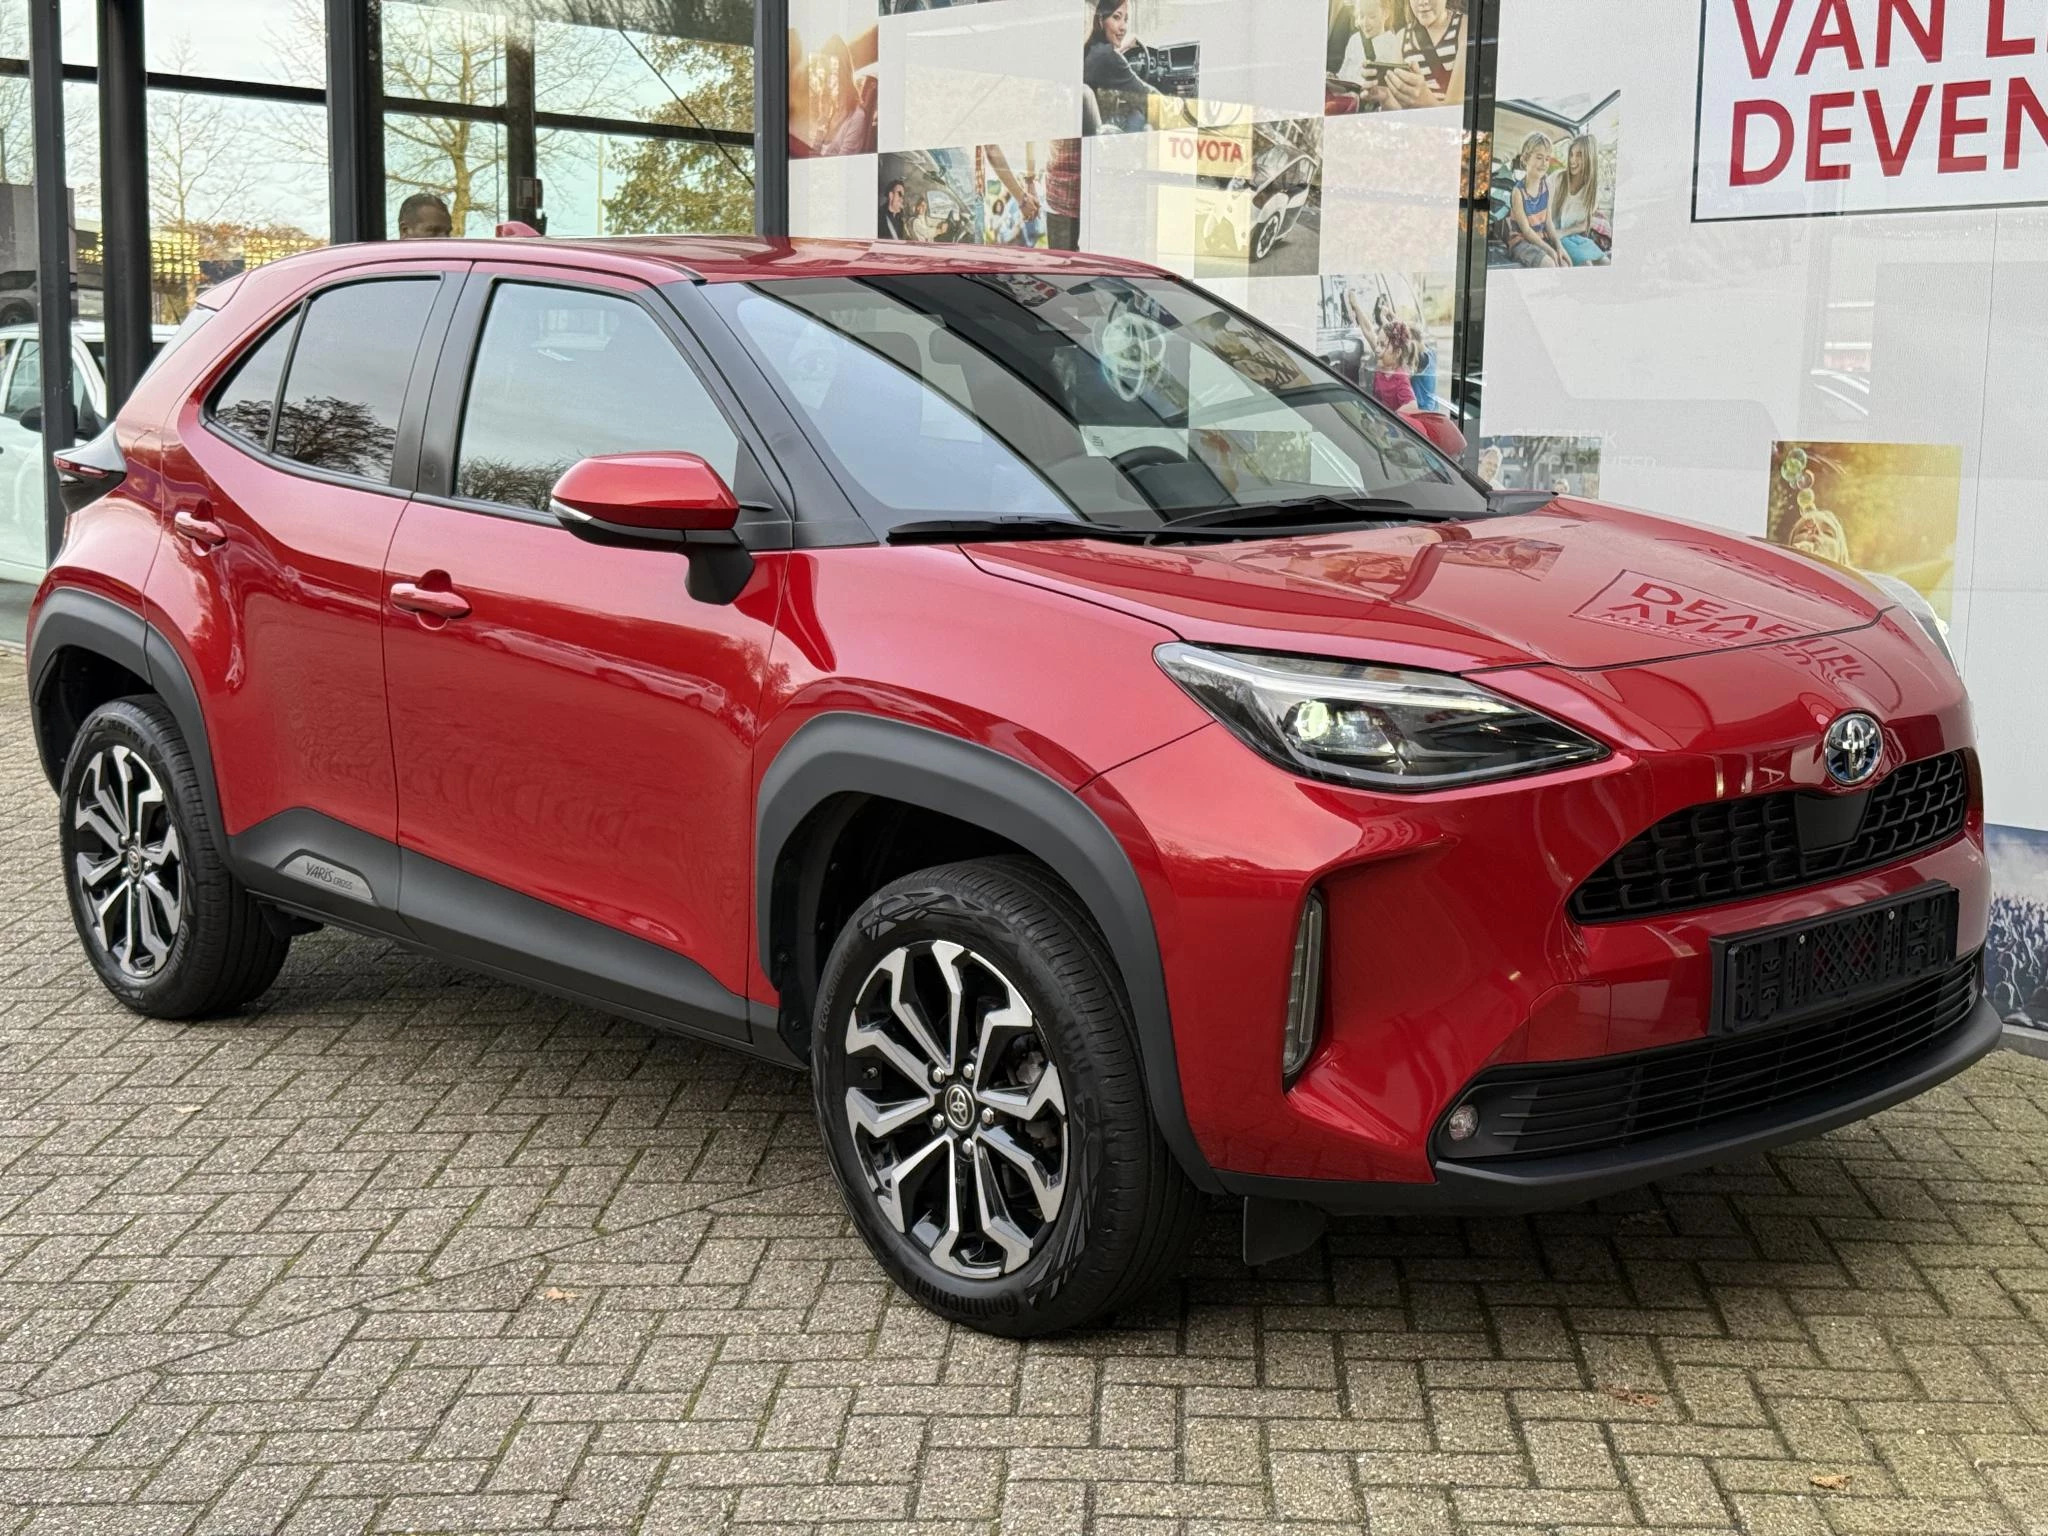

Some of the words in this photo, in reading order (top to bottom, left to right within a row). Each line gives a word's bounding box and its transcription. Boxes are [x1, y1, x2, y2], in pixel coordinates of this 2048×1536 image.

[1731, 0, 1945, 80] VAN
[1168, 137, 1244, 162] TOYOTA
[306, 862, 334, 882] YARIS
